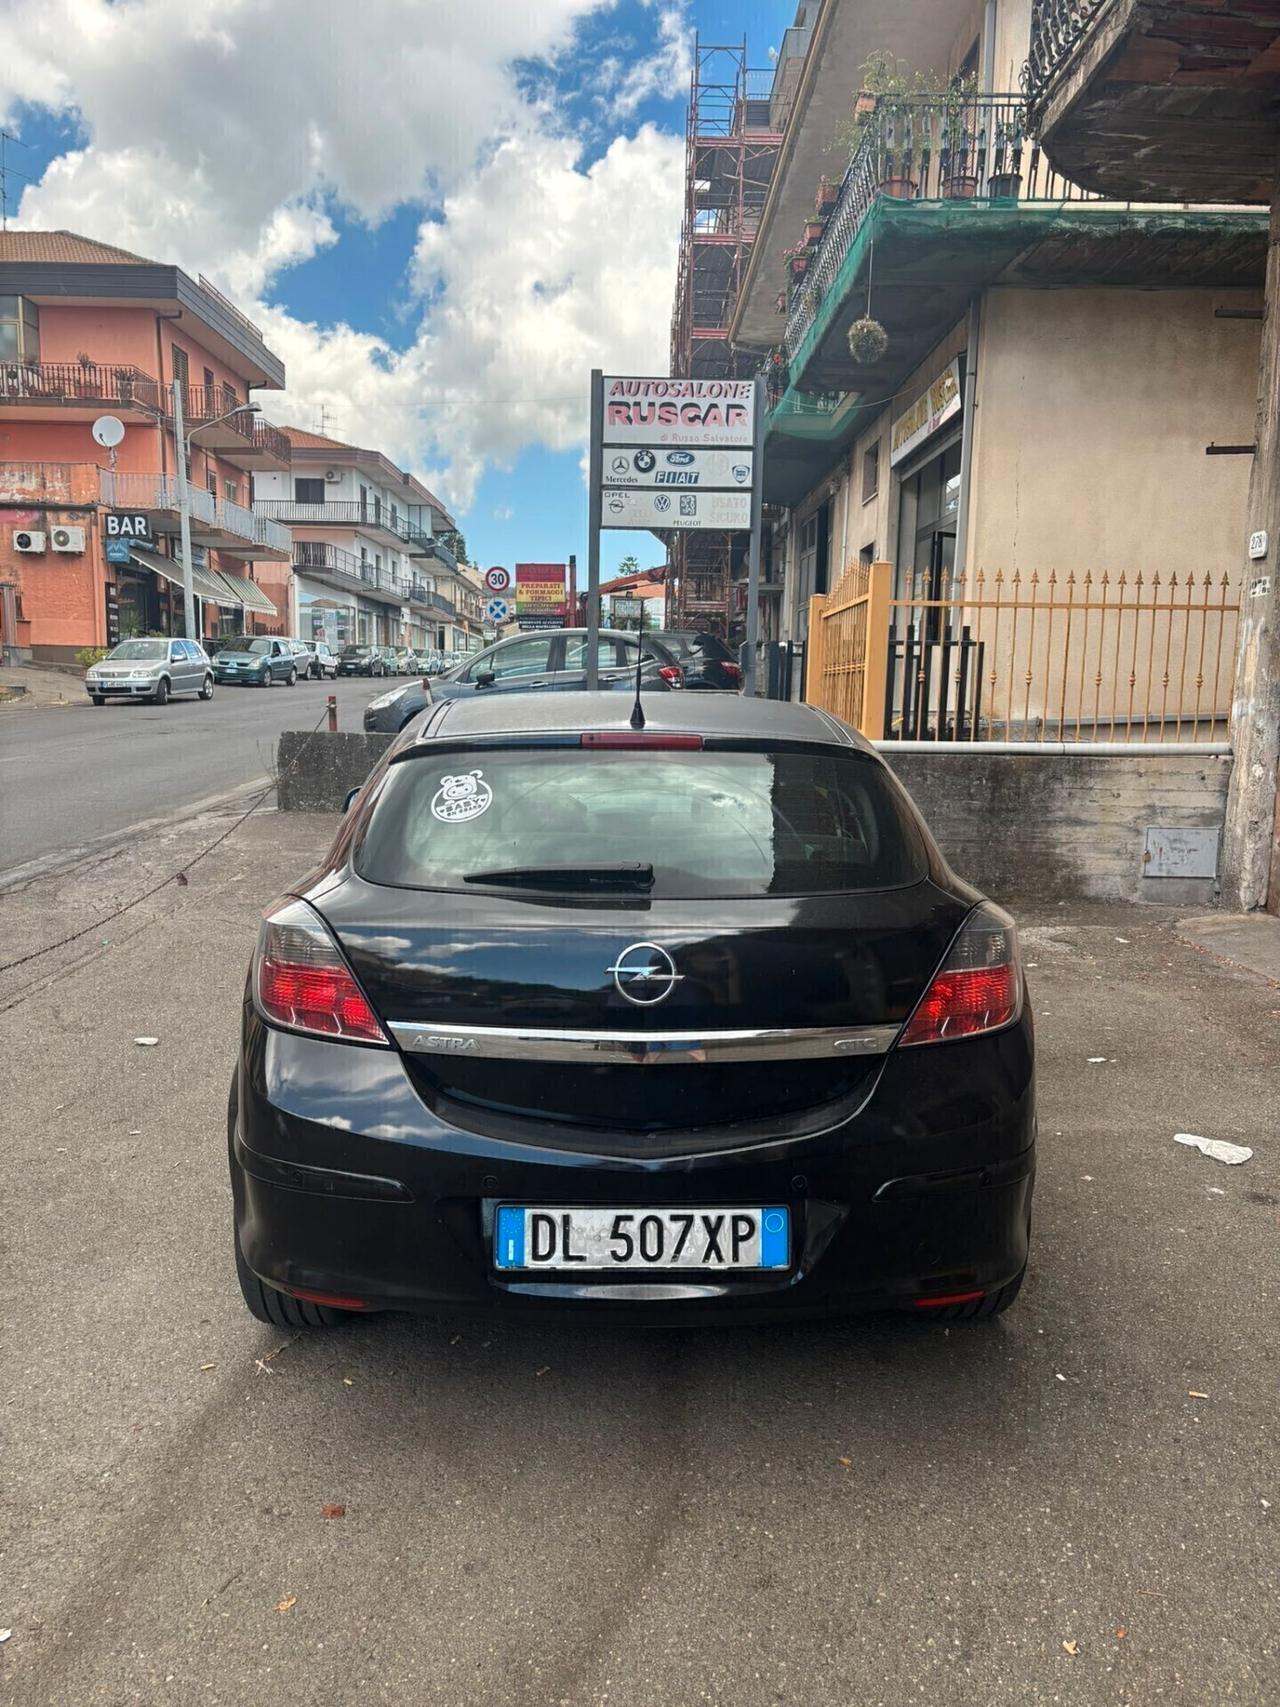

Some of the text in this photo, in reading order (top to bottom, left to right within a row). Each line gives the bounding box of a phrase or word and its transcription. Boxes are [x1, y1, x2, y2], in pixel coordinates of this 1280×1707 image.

[610, 381, 752, 399] AUTOSALONE
[608, 401, 748, 427] RUSCAR
[660, 432, 748, 443] di Russo Salvatore
[605, 475, 639, 484] Mercedes
[655, 471, 699, 484] FIAT
[604, 491, 631, 499] OPEL
[107, 516, 147, 535] BAR
[672, 519, 702, 527] PEUGEOT
[490, 573, 505, 585] 30
[445, 797, 480, 812] BABY
[412, 1034, 481, 1050] ASTRA
[530, 1213, 587, 1263] DL
